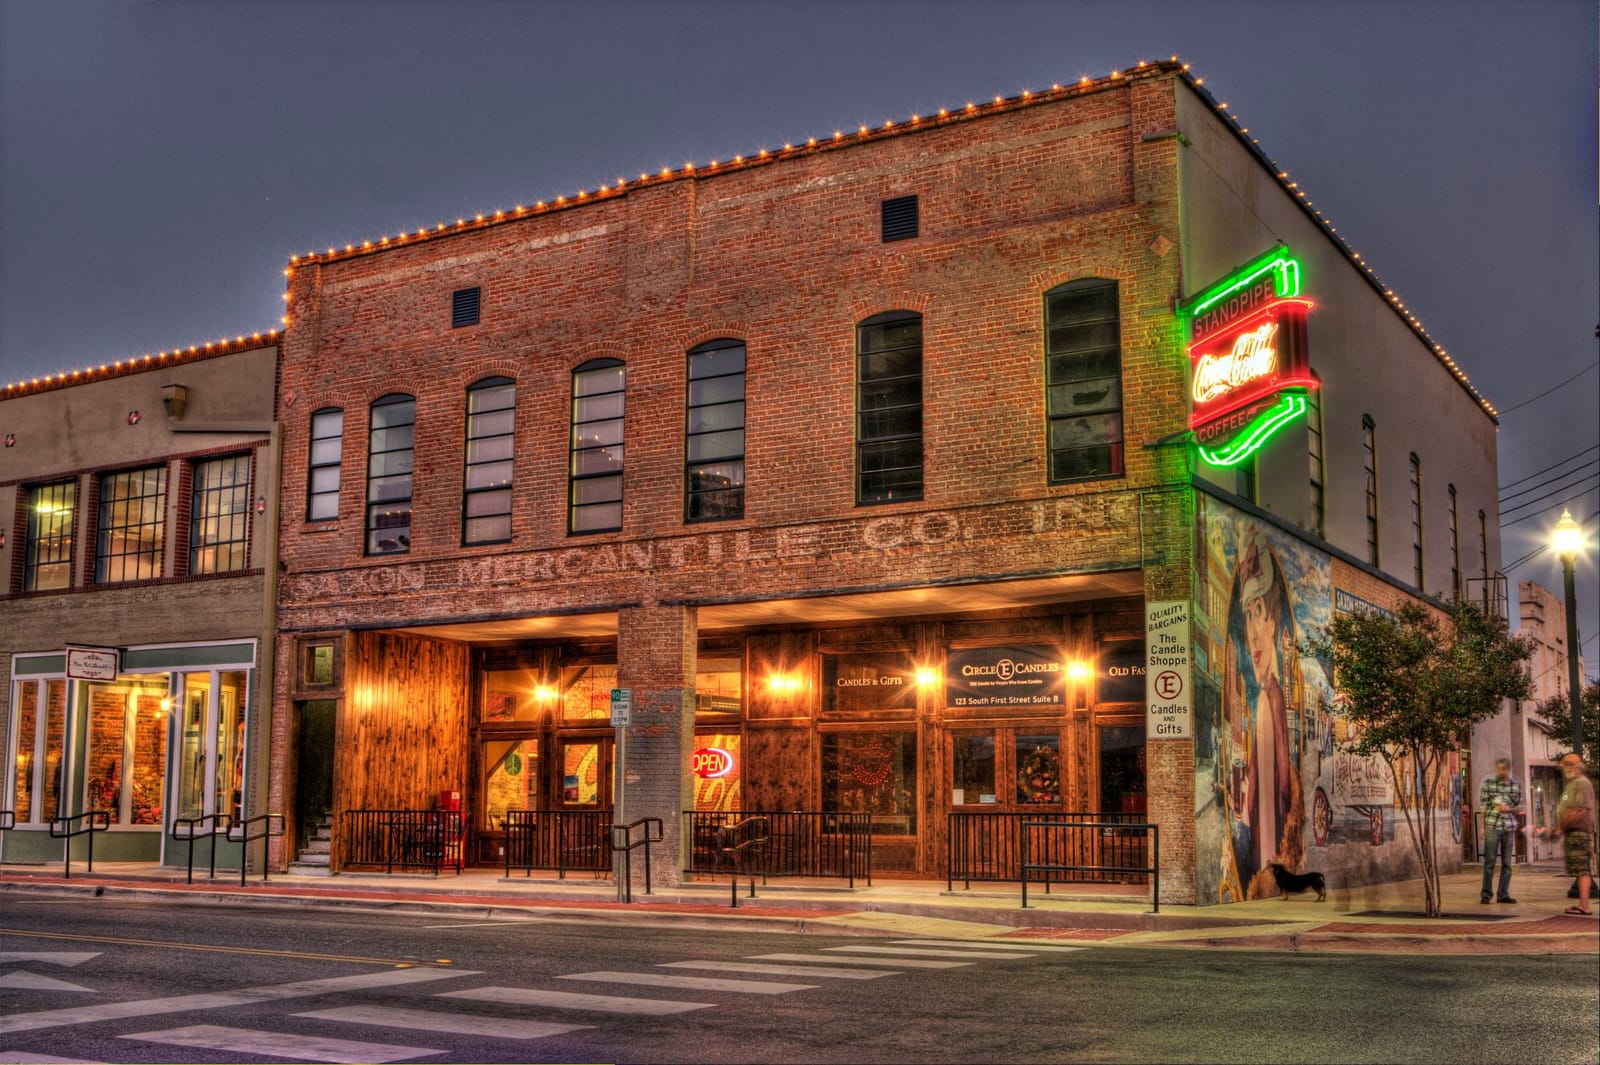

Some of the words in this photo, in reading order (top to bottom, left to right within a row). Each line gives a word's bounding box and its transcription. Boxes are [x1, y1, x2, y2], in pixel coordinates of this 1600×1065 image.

[1195, 279, 1273, 338] STANDPIPE
[1199, 411, 1245, 442] COFFEE
[298, 564, 425, 596] SAXON
[457, 523, 822, 588] MERCANTILE
[1150, 604, 1183, 620] QUALITY
[1148, 614, 1187, 632] BARGAINS
[1160, 634, 1176, 643] The
[1151, 645, 1185, 655] Candle
[1150, 656, 1187, 667] Shoppe
[955, 697, 967, 705] 123
[969, 697, 988, 705] South
[1033, 695, 1051, 703] Suite
[1151, 704, 1188, 714] Candles
[1156, 724, 1182, 735] Gifts
[692, 754, 725, 772] OPEN
